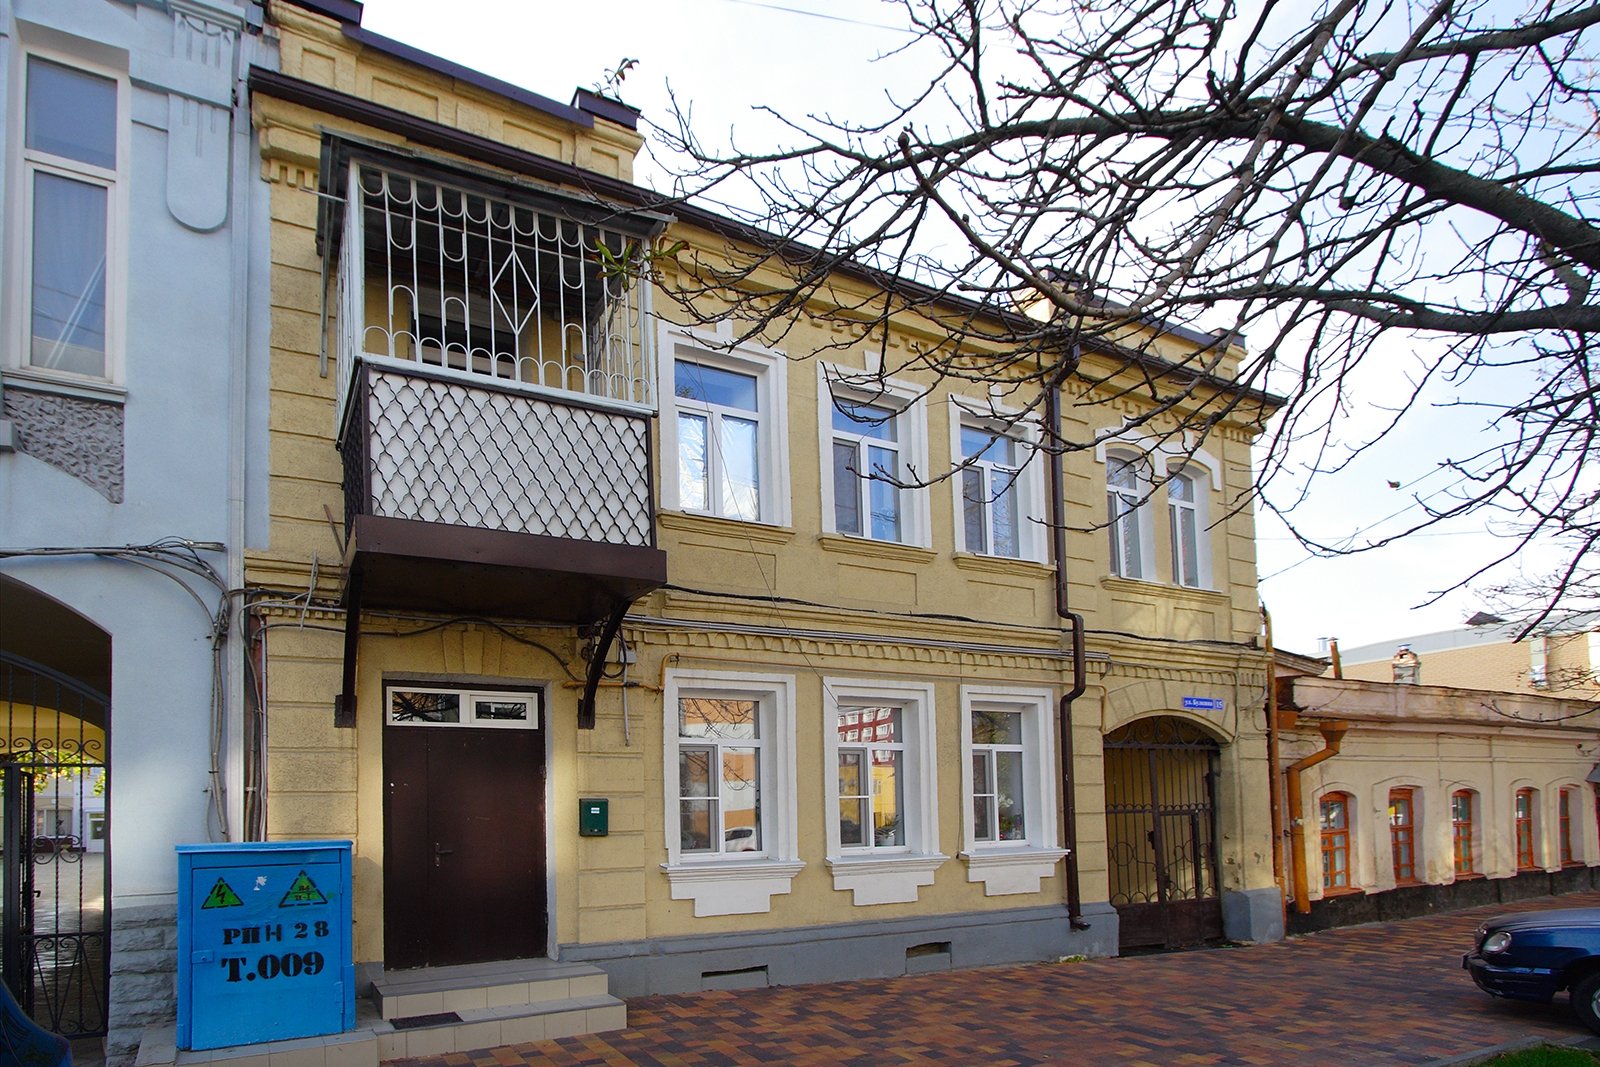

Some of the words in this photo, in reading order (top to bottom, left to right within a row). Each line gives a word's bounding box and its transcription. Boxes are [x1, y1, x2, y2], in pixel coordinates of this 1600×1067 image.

[223, 924, 282, 945] РПН
[294, 921, 329, 939] 28
[221, 951, 324, 982] Т.009
